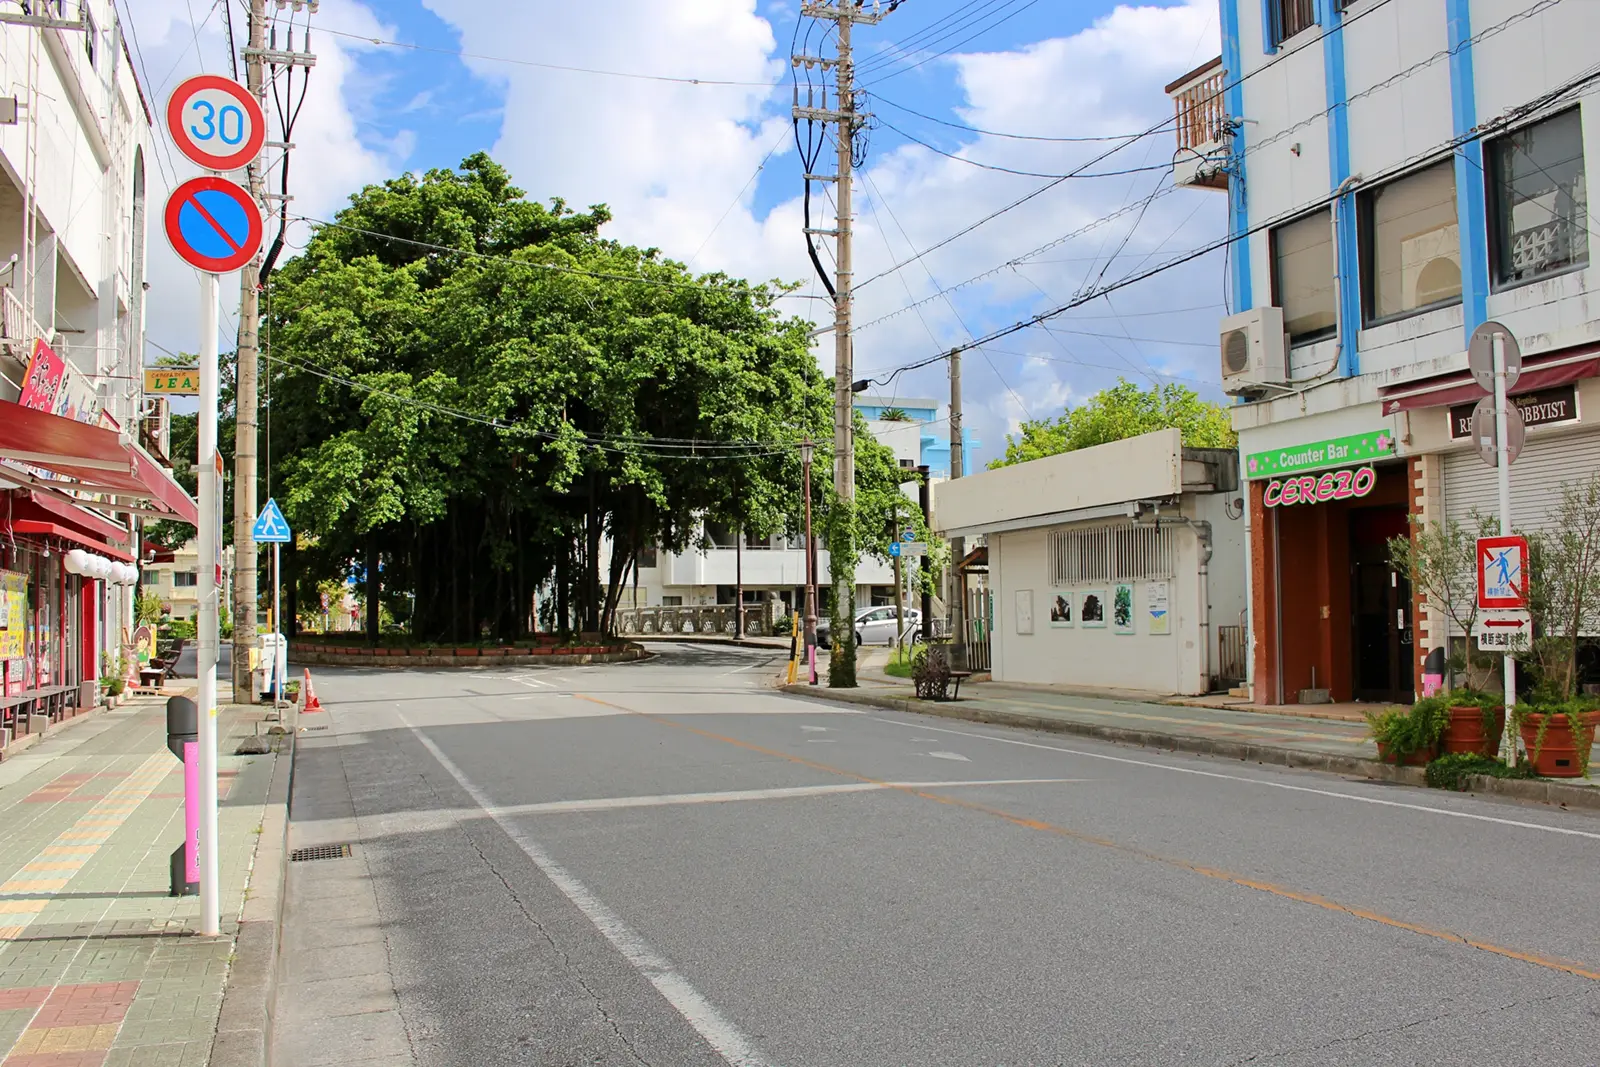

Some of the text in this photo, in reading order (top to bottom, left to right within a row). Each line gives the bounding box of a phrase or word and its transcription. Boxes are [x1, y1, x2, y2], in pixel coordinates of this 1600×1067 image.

[191, 100, 244, 145] 30
[154, 377, 199, 389] LEA
[1459, 400, 1566, 433] RE OBBYIST
[1279, 444, 1349, 468] Counter Bar
[1264, 467, 1375, 508] CEREZO
